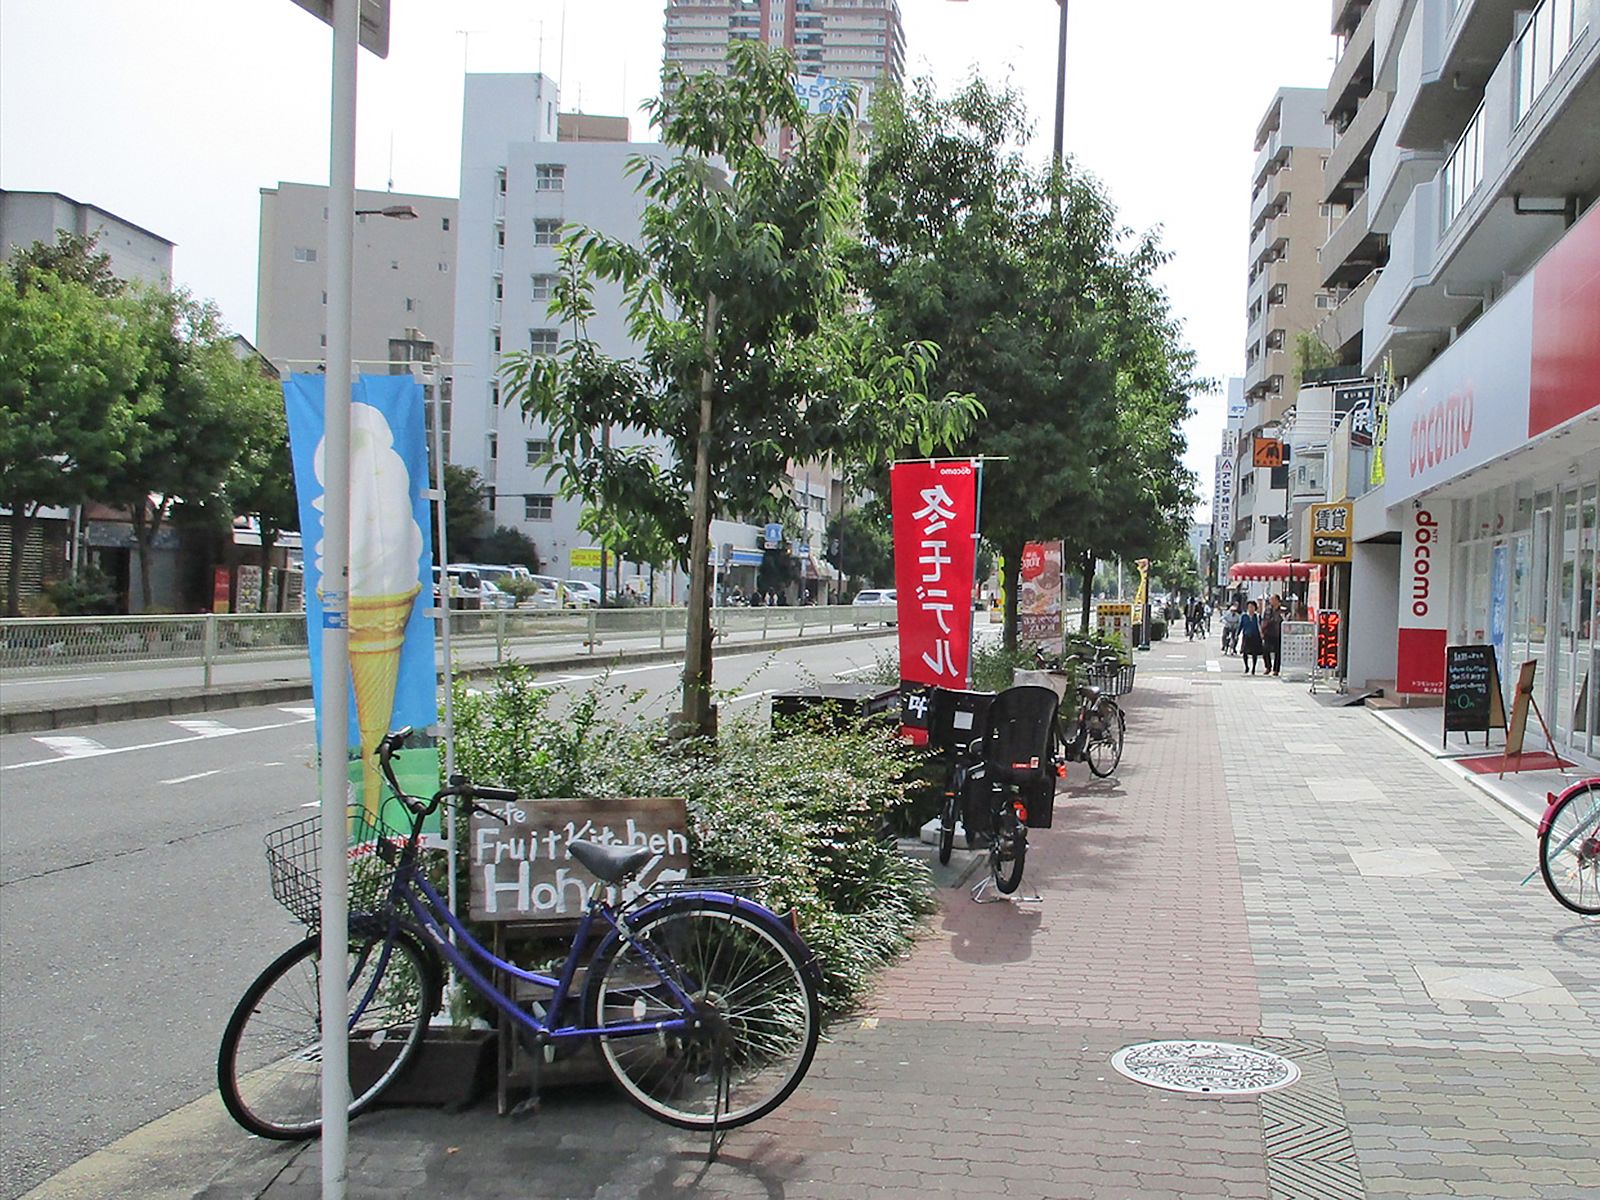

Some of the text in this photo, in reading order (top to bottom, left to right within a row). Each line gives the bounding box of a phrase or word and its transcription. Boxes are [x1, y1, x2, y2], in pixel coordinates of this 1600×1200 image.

[1314, 508, 1347, 532] 賃貸
[1412, 510, 1438, 617] docomo
[474, 828, 561, 866] Fruit
